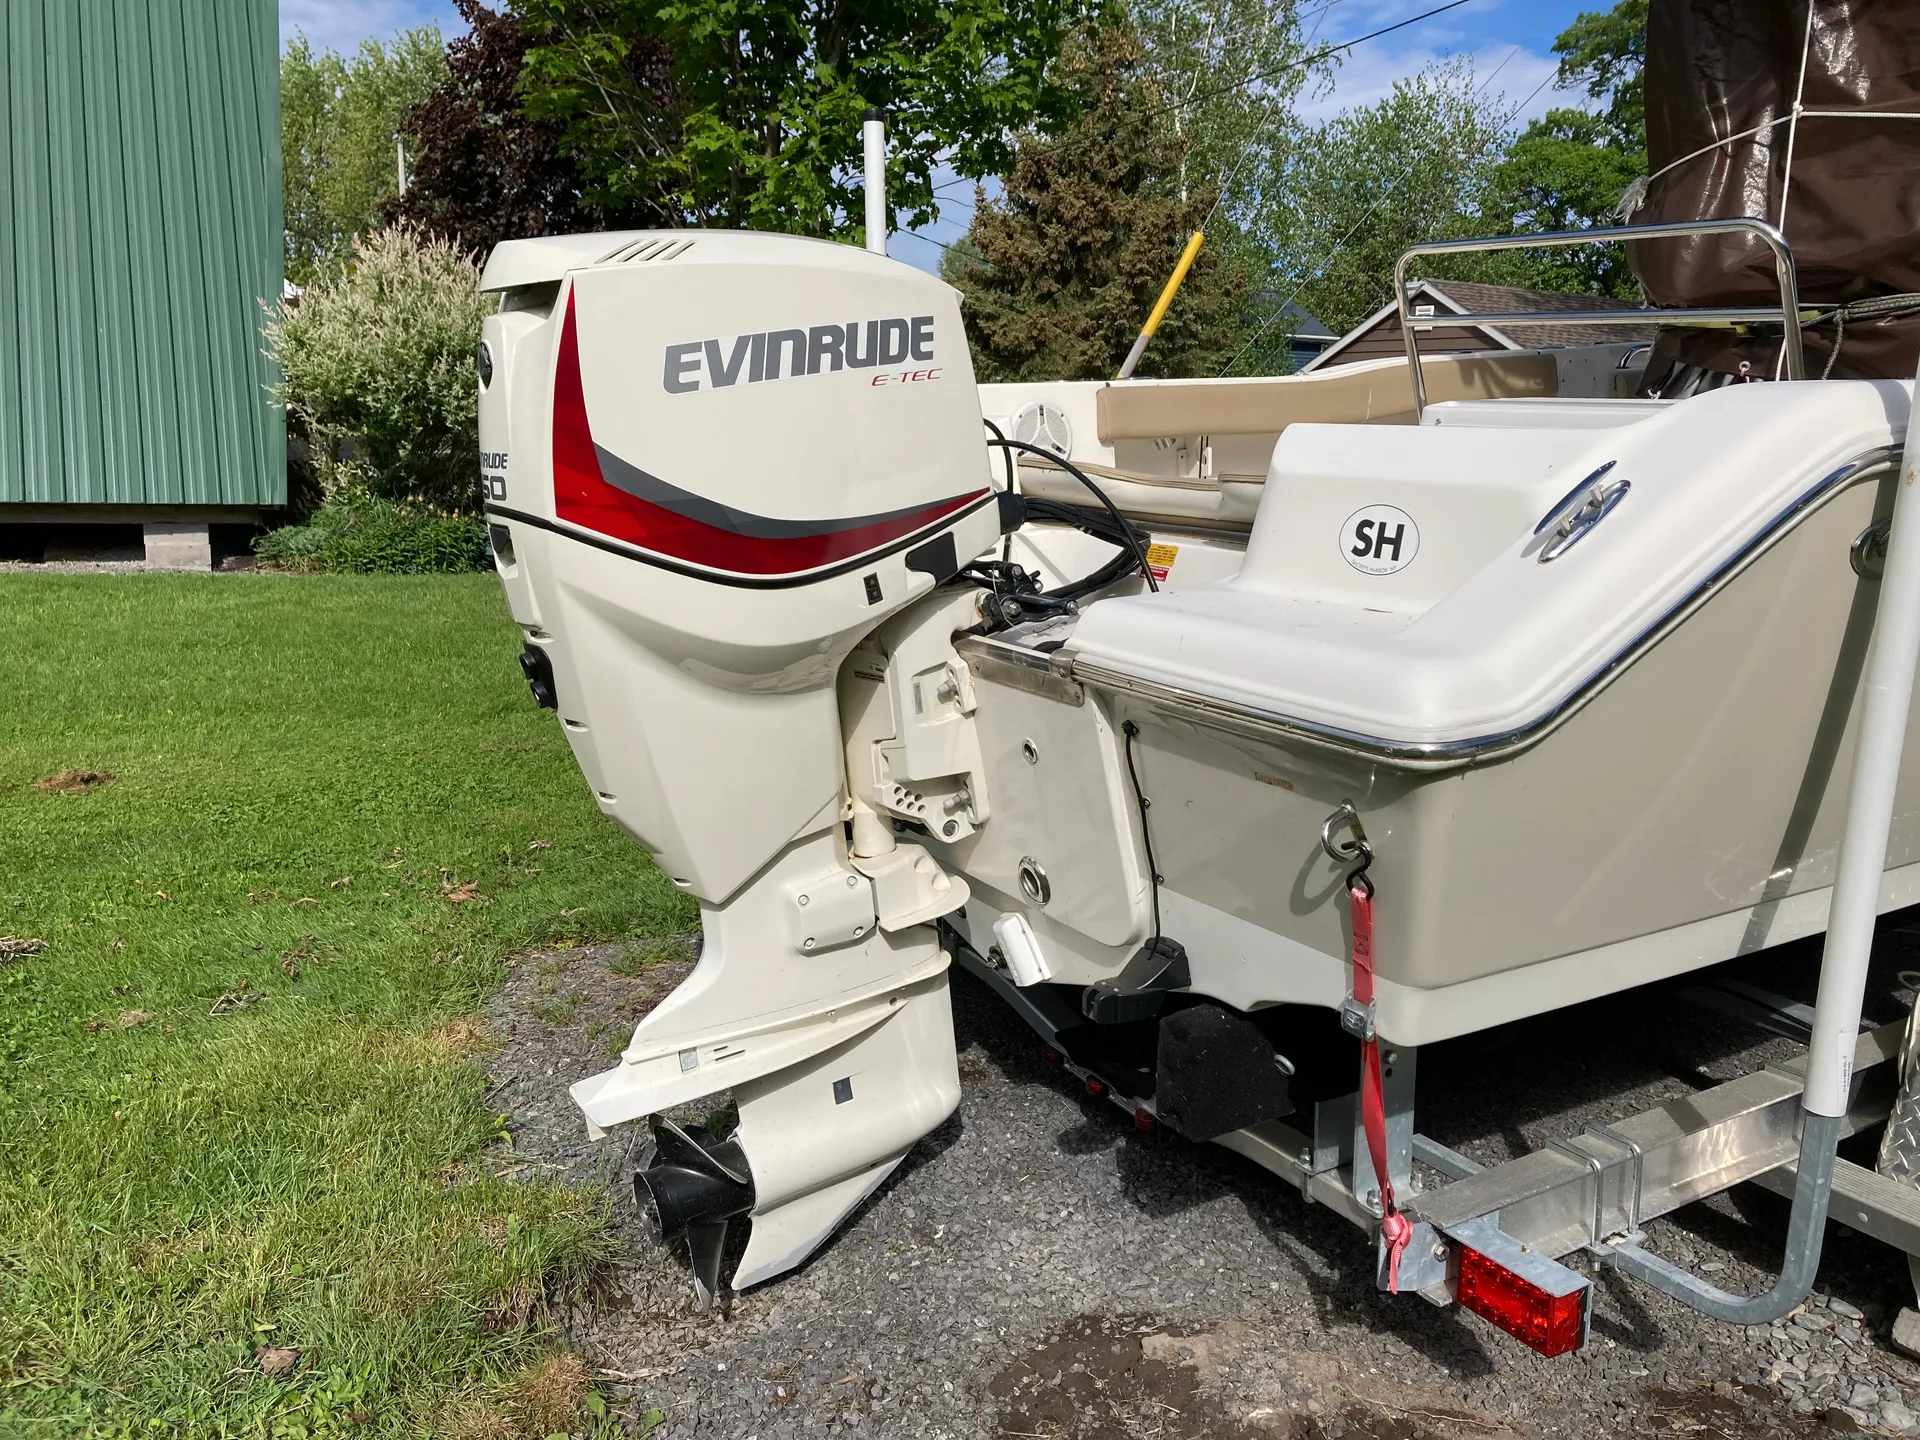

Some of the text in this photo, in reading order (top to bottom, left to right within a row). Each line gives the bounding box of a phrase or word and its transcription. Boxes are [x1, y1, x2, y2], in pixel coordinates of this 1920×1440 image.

[663, 315, 934, 395] EVINRUDE
[871, 368, 944, 387] E-TEC
[1351, 519, 1405, 562] SH
